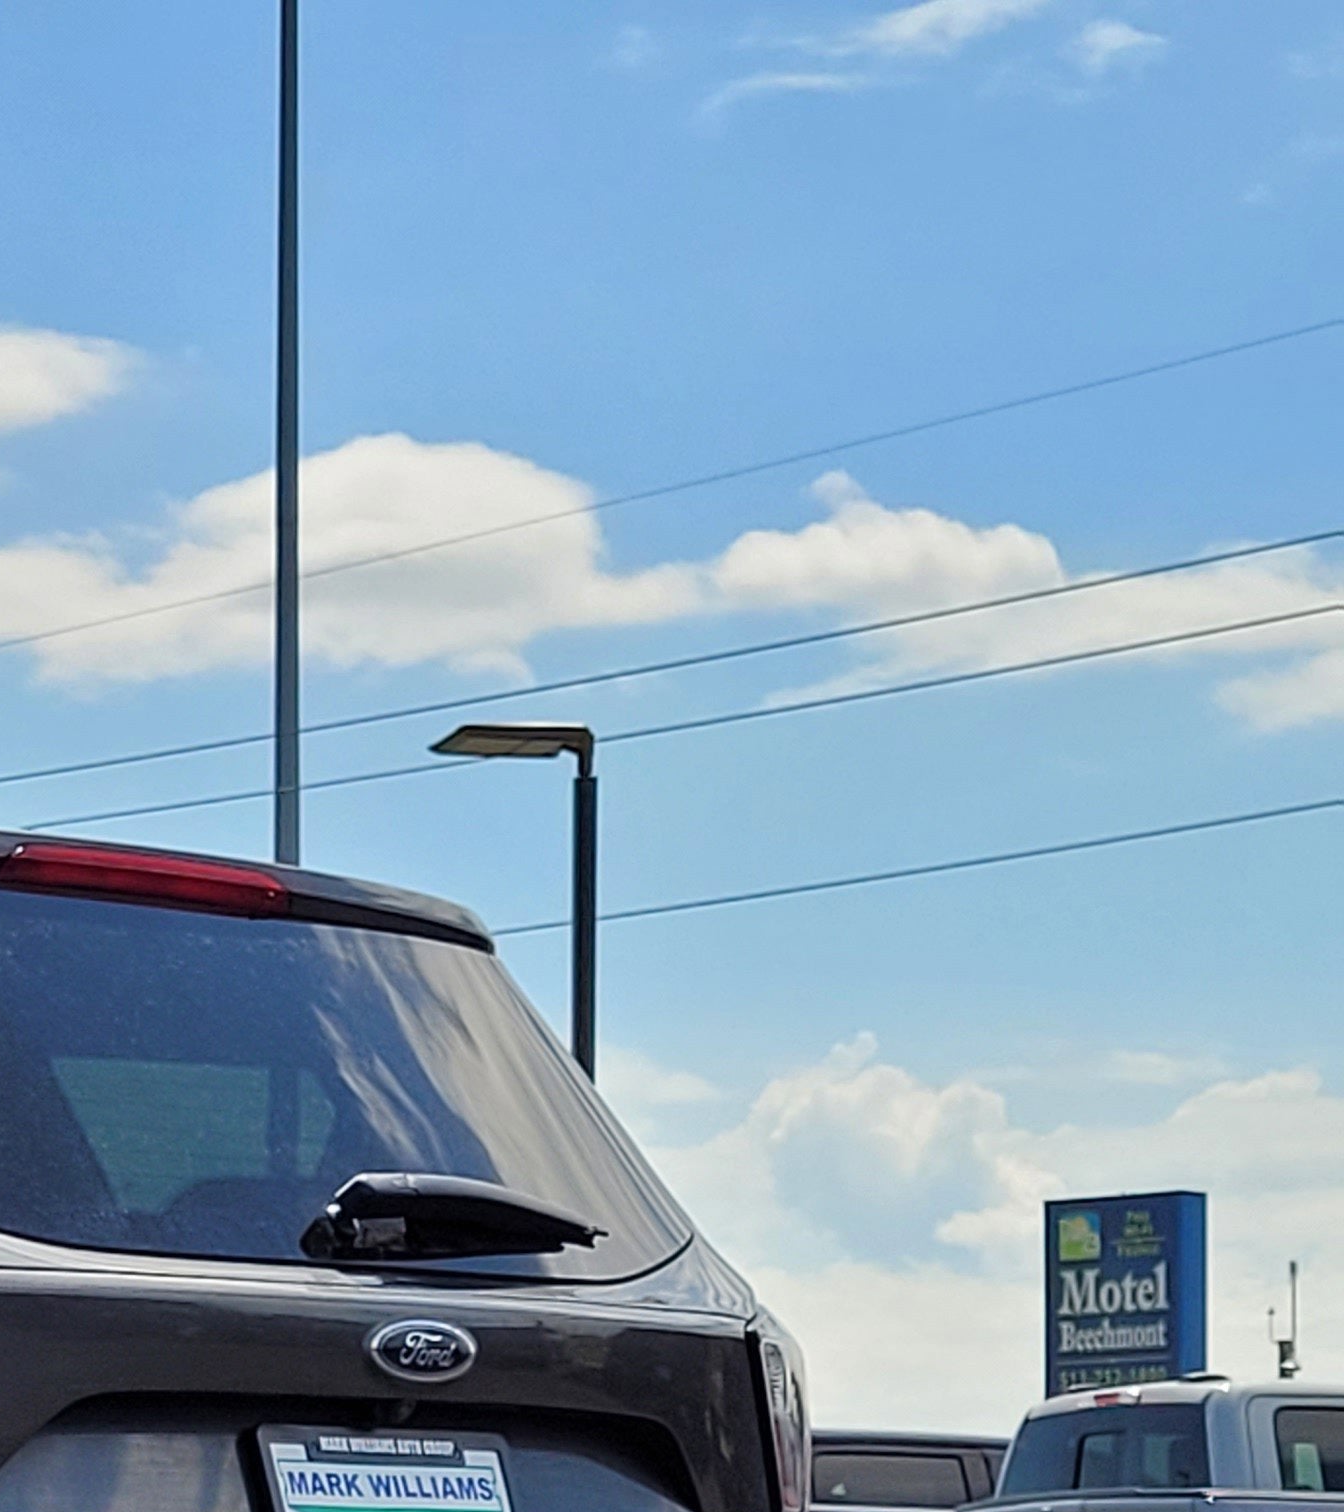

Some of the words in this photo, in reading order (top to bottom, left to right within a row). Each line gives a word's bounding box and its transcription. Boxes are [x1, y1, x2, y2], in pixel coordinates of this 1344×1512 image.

[1059, 1261, 1169, 1315] Motel
[400, 1331, 457, 1367] Ford
[1059, 1318, 1167, 1353] Beechmont
[287, 1471, 364, 1497] MARK
[366, 1474, 494, 1501] WILLIAMS
